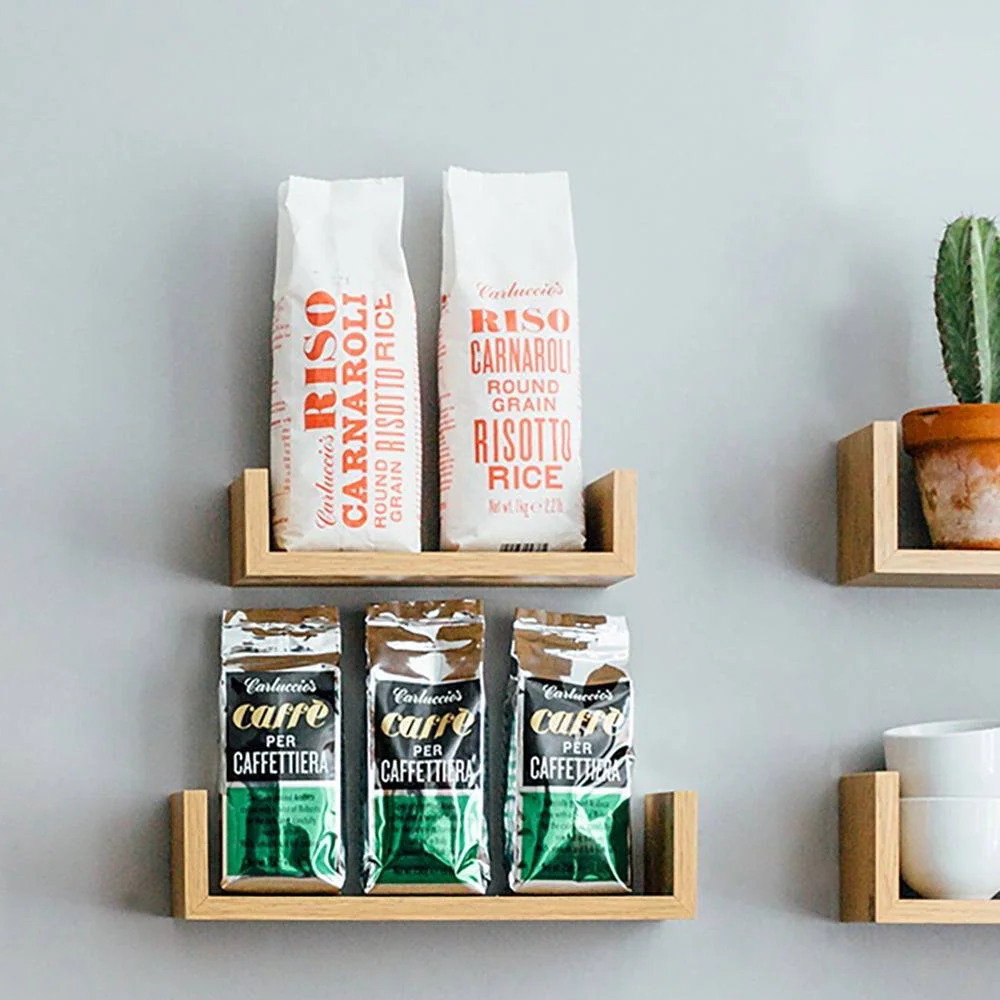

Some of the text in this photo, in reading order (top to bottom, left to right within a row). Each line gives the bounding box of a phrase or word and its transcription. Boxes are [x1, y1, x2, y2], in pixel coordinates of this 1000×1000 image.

[476, 280, 564, 300] Carluccio's
[470, 308, 570, 333] RISO
[304, 290, 338, 432] RISO
[470, 337, 571, 375] CARNAROLI
[374, 292, 405, 454] RISOTTO RICE
[487, 379, 560, 395] ROUND
[342, 294, 368, 529] CARNAROLI
[492, 397, 556, 413] GRAIN
[473, 418, 571, 464] RISOTTO
[488, 465, 564, 490] RICE
[375, 459, 387, 528] ROUND
[389, 460, 403, 522] GRAIN
[243, 676, 317, 695] Carluccio's
[392, 685, 463, 704] Carluccio's
[542, 683, 615, 703] Carluccio's
[232, 698, 331, 732] caffè
[381, 707, 475, 740] caffè
[530, 706, 626, 737] caffè
[266, 735, 297, 749] PER
[413, 743, 443, 757] PER
[563, 740, 593, 755] PER
[233, 750, 330, 776] CAFFETTIERA
[381, 757, 474, 783] CAFFETTIERA
[530, 755, 622, 782] CAFFETTIERA
